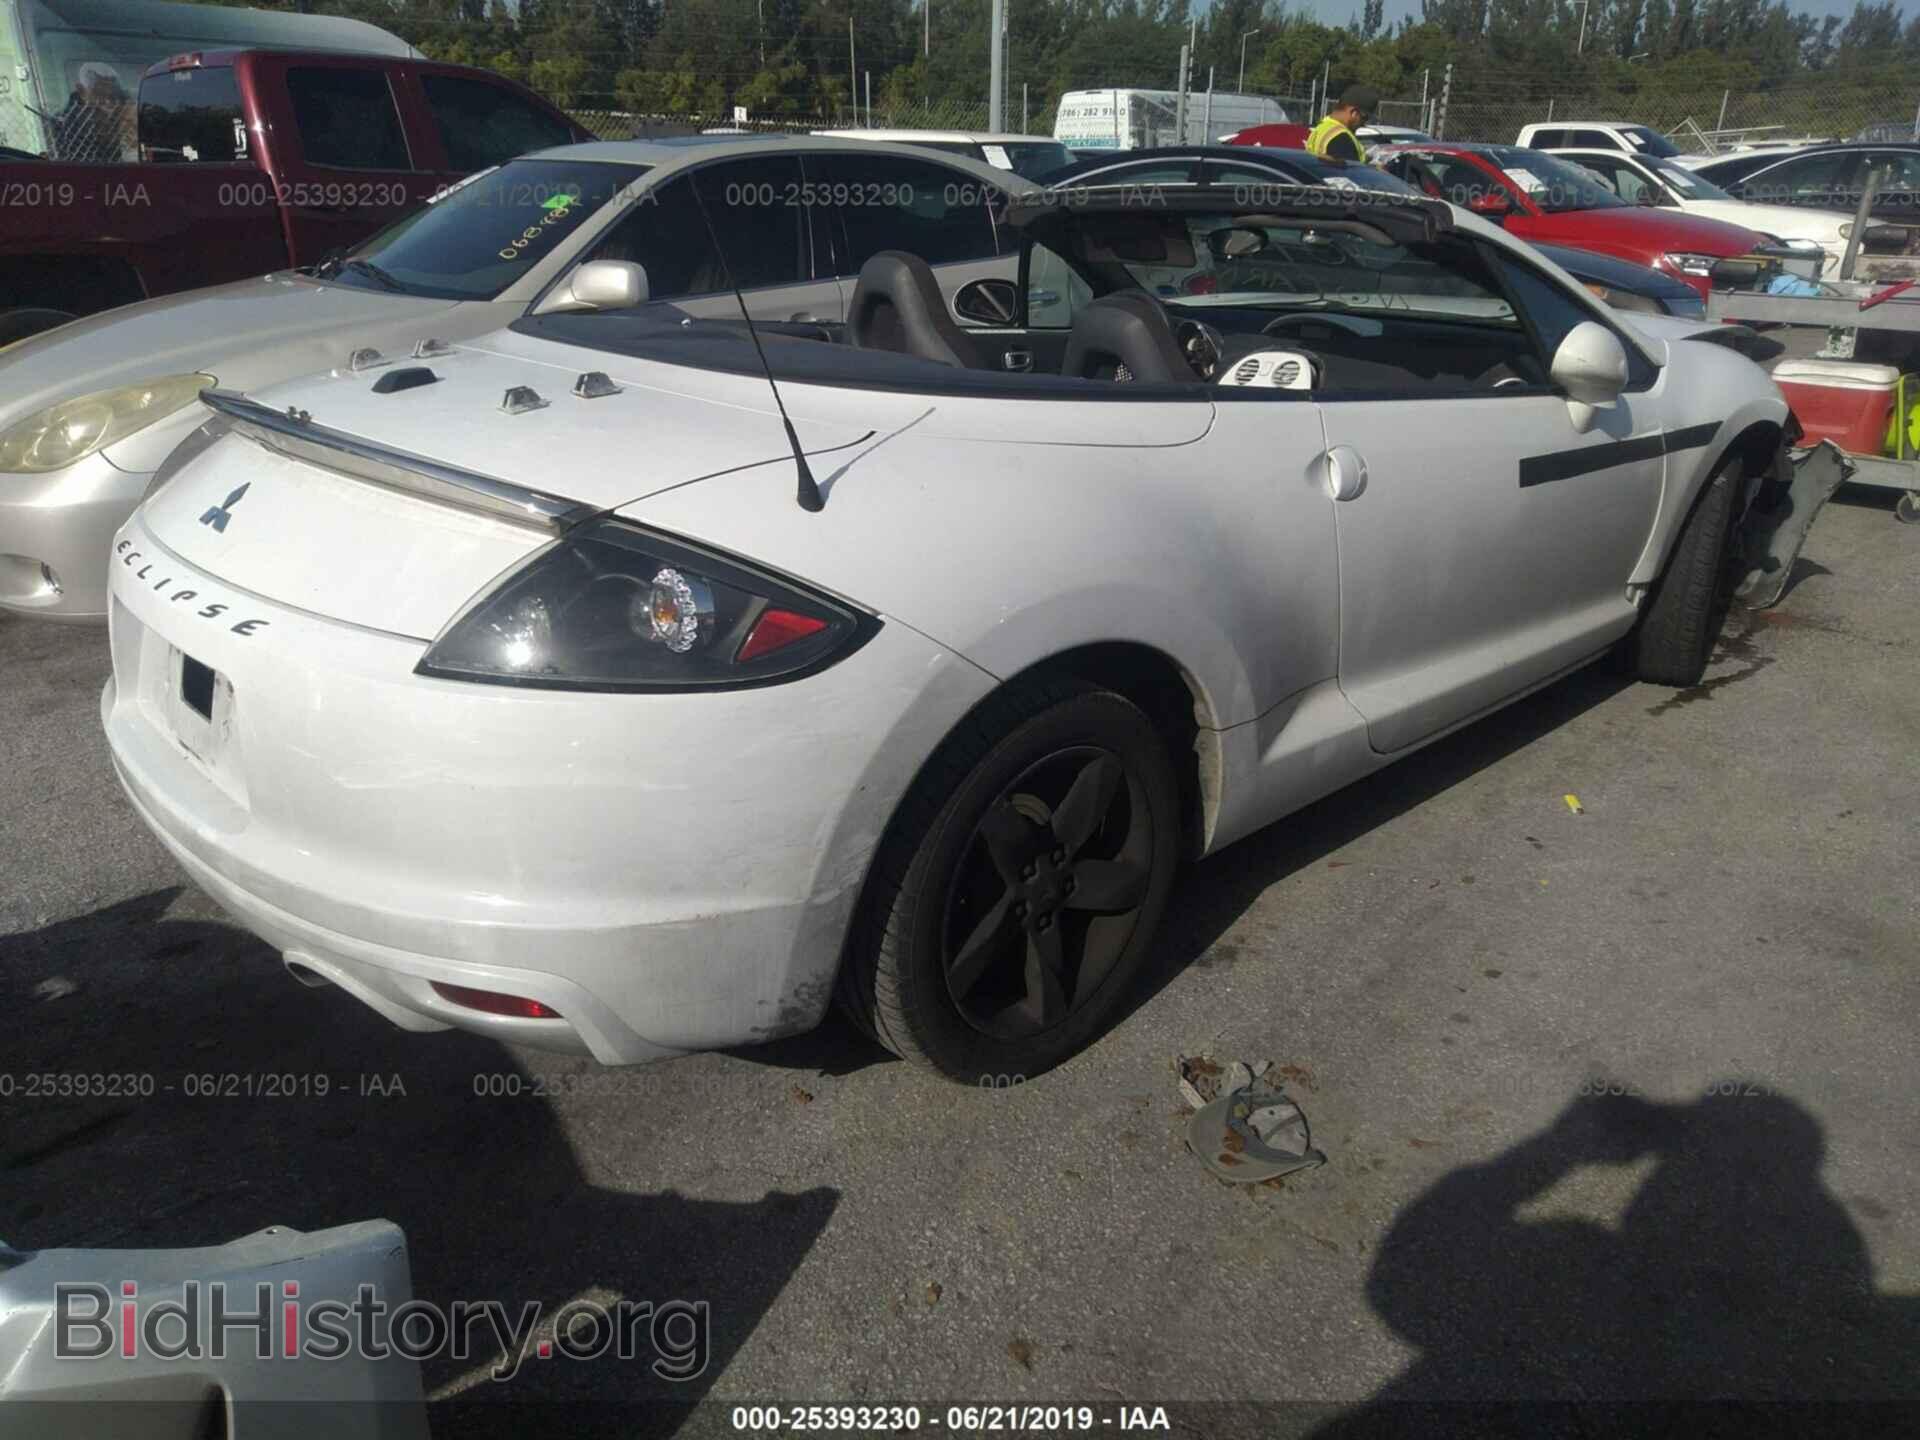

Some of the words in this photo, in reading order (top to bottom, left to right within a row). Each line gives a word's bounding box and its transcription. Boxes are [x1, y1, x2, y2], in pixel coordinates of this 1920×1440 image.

[1082, 107, 1098, 117] 282
[1102, 106, 1126, 116] 910
[116, 540, 271, 636] ECLIPSE
